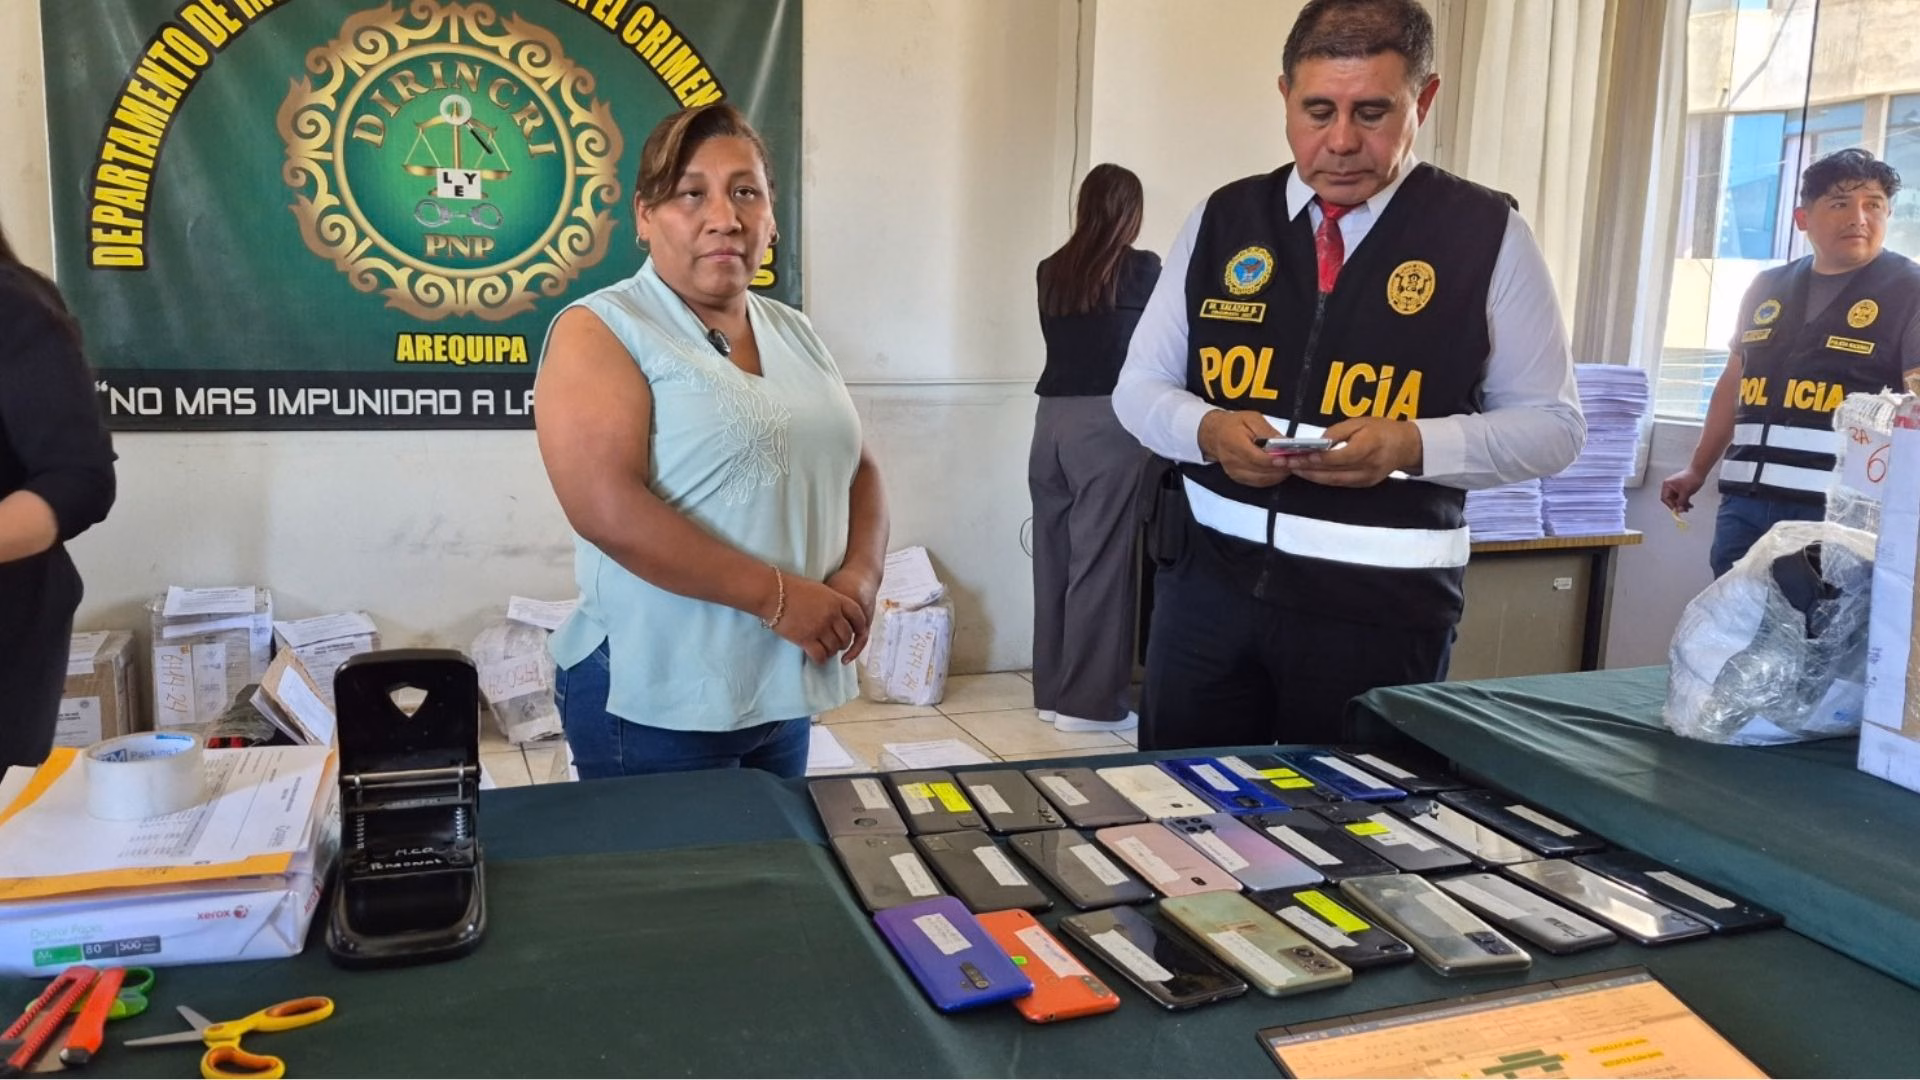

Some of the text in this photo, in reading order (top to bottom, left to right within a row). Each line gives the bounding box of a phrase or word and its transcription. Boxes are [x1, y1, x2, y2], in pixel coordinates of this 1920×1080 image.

[622, 5, 723, 108] CRIMEN
[353, 61, 557, 158] DIRINCRI
[92, 0, 243, 266] DEPARTAMENTO DE
[424, 233, 495, 258] PNP
[396, 334, 528, 364] AREQUIPA
[1200, 345, 1278, 400] POL
[175, 387, 256, 415] MAS
[269, 388, 462, 415] IMPUNIDAD
[472, 389, 494, 415] A
[1740, 377, 1768, 405] POL
[197, 908, 230, 920] xerox
[85, 943, 102, 955] 80
[119, 940, 141, 951] 500
